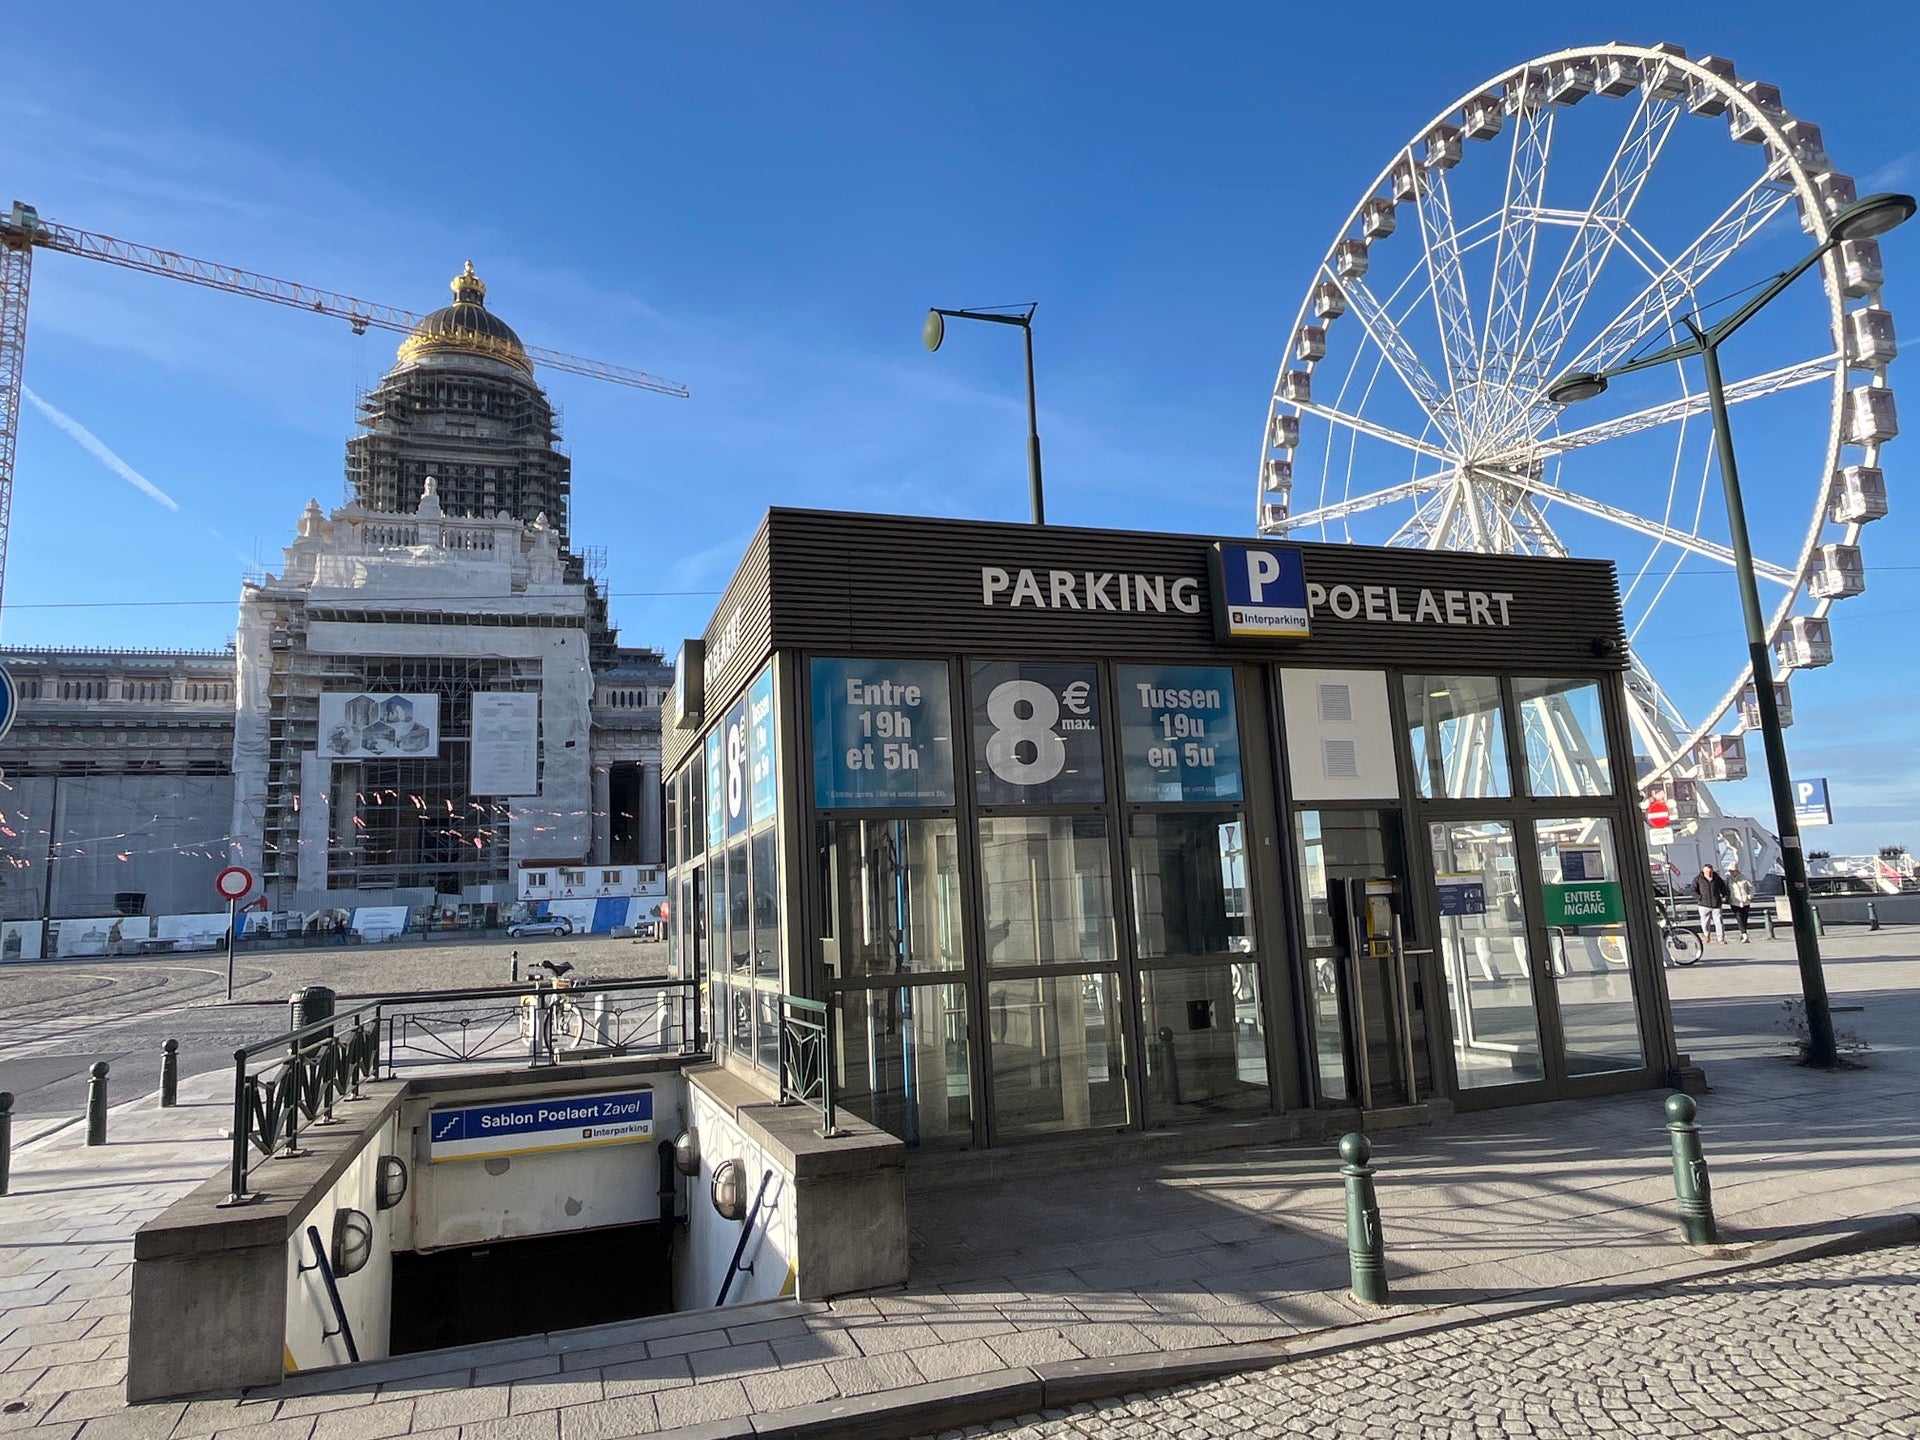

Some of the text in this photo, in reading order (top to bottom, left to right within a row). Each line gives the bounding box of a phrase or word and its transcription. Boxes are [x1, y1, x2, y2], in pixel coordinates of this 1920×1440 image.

[1245, 550, 1280, 602] P
[981, 566, 1514, 627] PARKING POELAERT
[1243, 612, 1307, 627] Interparking
[846, 678, 921, 706] Entre
[1136, 683, 1221, 709] Tussen
[858, 710, 912, 738] 19h
[985, 679, 1091, 785] 8 €
[1061, 718, 1096, 730] max.
[1159, 712, 1205, 738] 19u
[846, 742, 875, 770] et
[1147, 746, 1178, 768] en
[727, 723, 742, 819] 8
[1797, 783, 1814, 804] P
[1563, 890, 1603, 903] ENTREE
[1563, 902, 1606, 916] INGANG
[481, 1100, 641, 1128] Sablon Poelaert Zavel
[593, 1123, 649, 1137] Interparking
